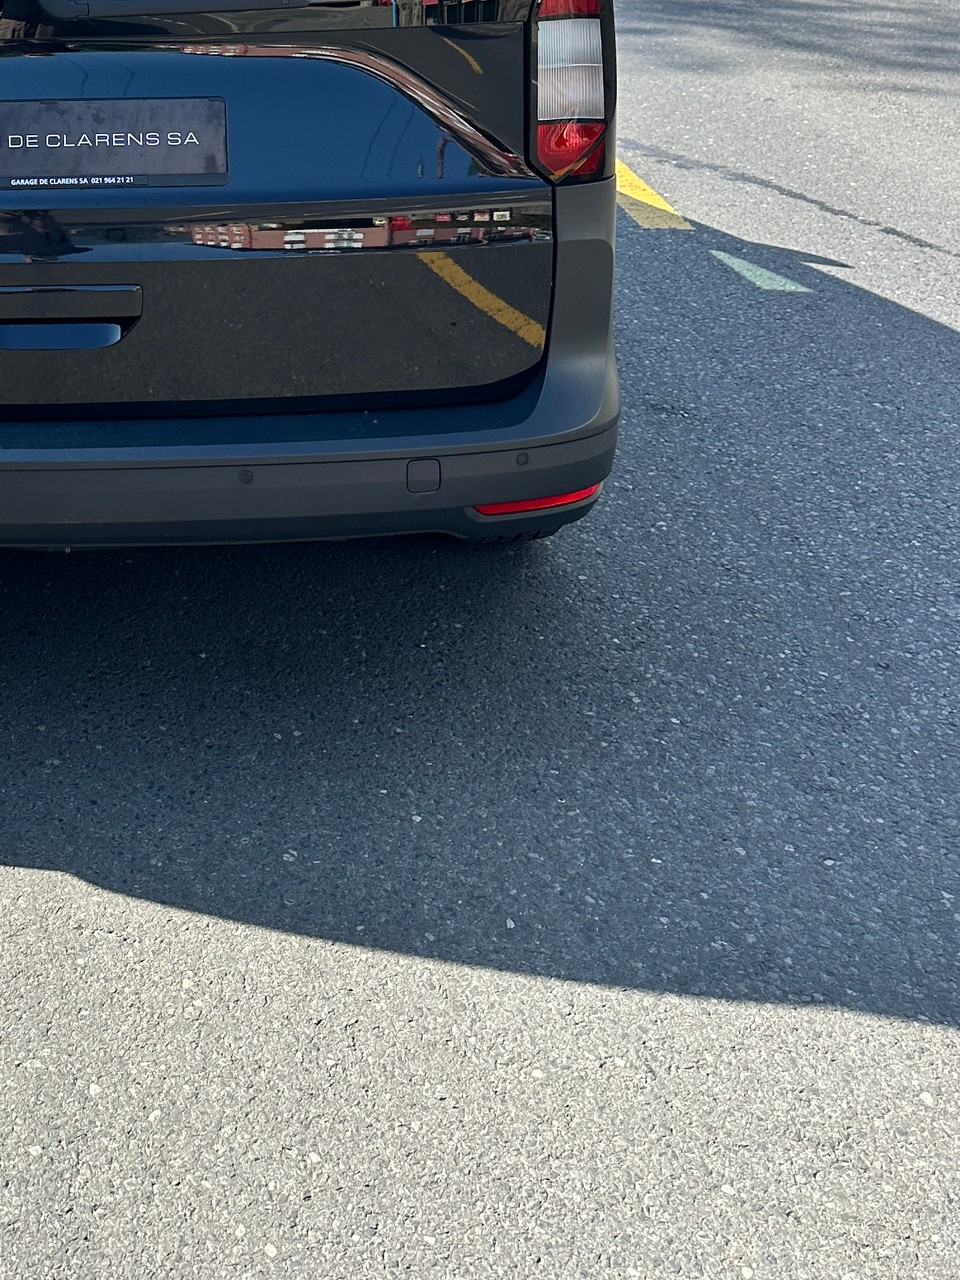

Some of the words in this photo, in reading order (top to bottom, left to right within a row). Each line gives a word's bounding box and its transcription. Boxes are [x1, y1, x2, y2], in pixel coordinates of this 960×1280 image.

[8, 134, 39, 148] DE
[45, 132, 161, 148] CLARENS
[167, 132, 200, 145] SA
[10, 178, 38, 186] GARAGE
[39, 178, 48, 186] DE
[49, 178, 78, 186] CLARENS
[104, 177, 115, 185] 964
